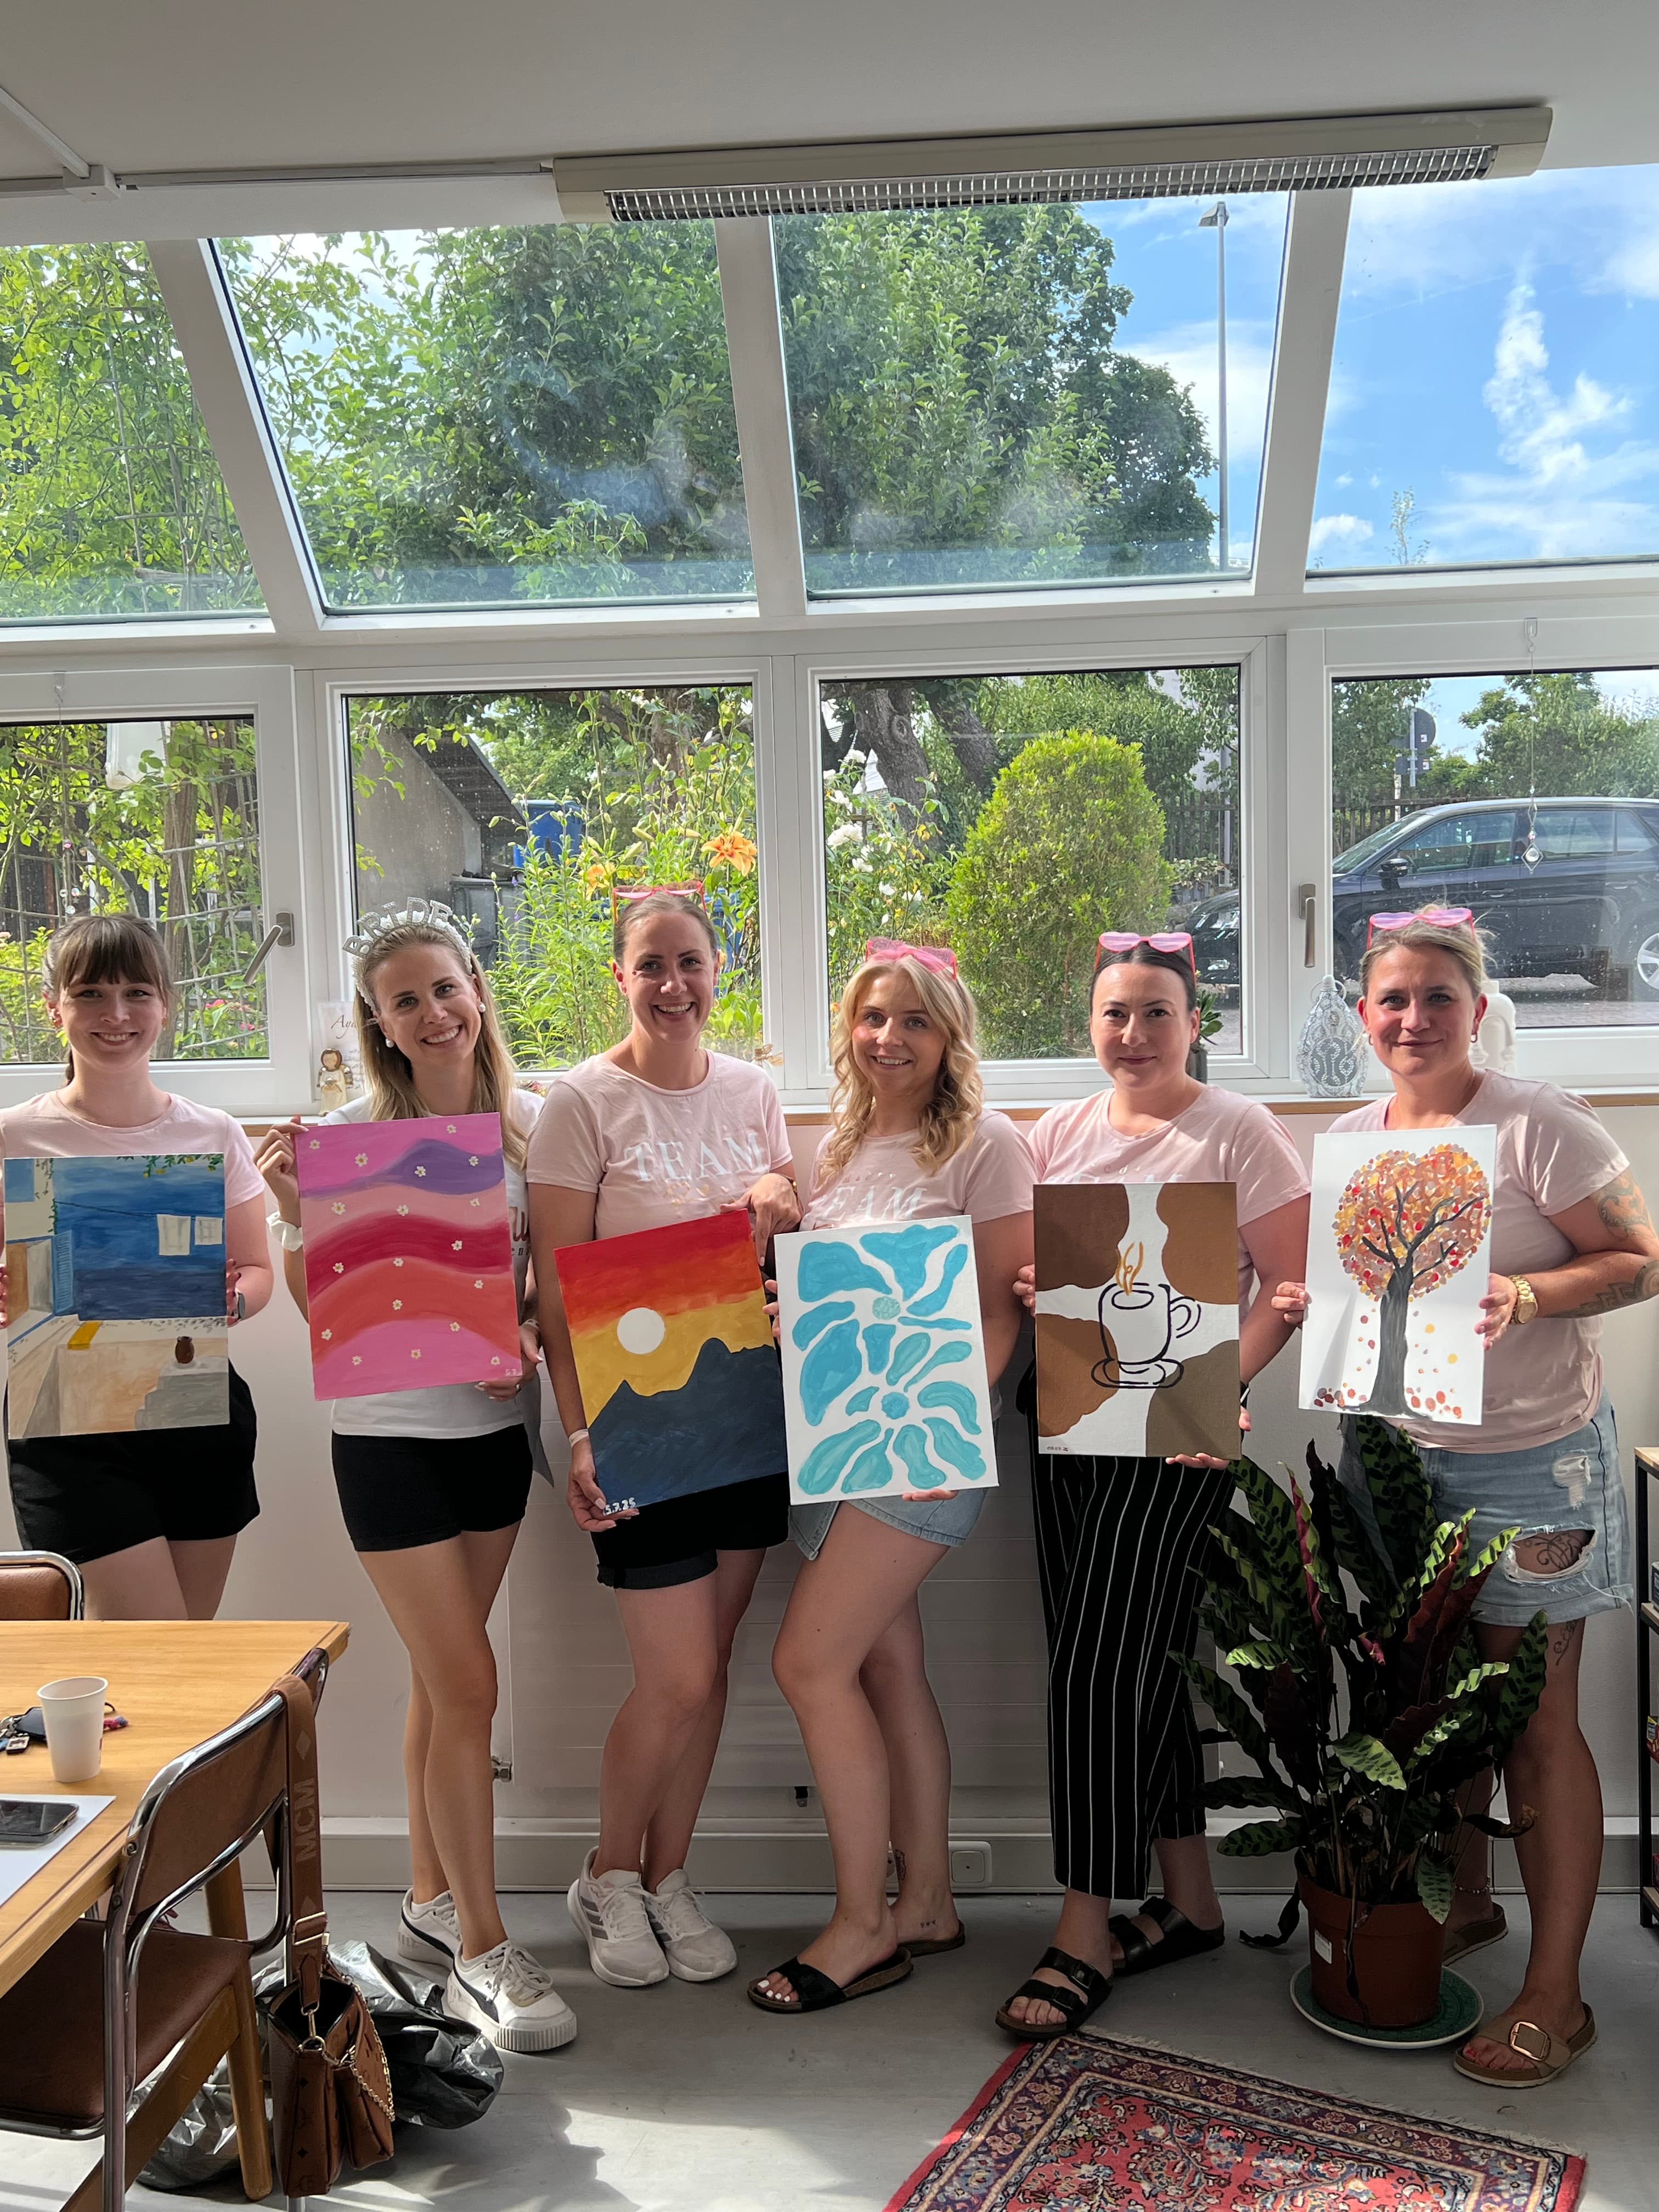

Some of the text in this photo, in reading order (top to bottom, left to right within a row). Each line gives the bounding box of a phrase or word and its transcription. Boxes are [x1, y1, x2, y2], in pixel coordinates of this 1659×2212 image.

[342, 896, 453, 958] BRIDE
[623, 1130, 770, 1182] TEAM
[811, 1185, 928, 1222] EAM
[294, 1777, 317, 1863] MCM
